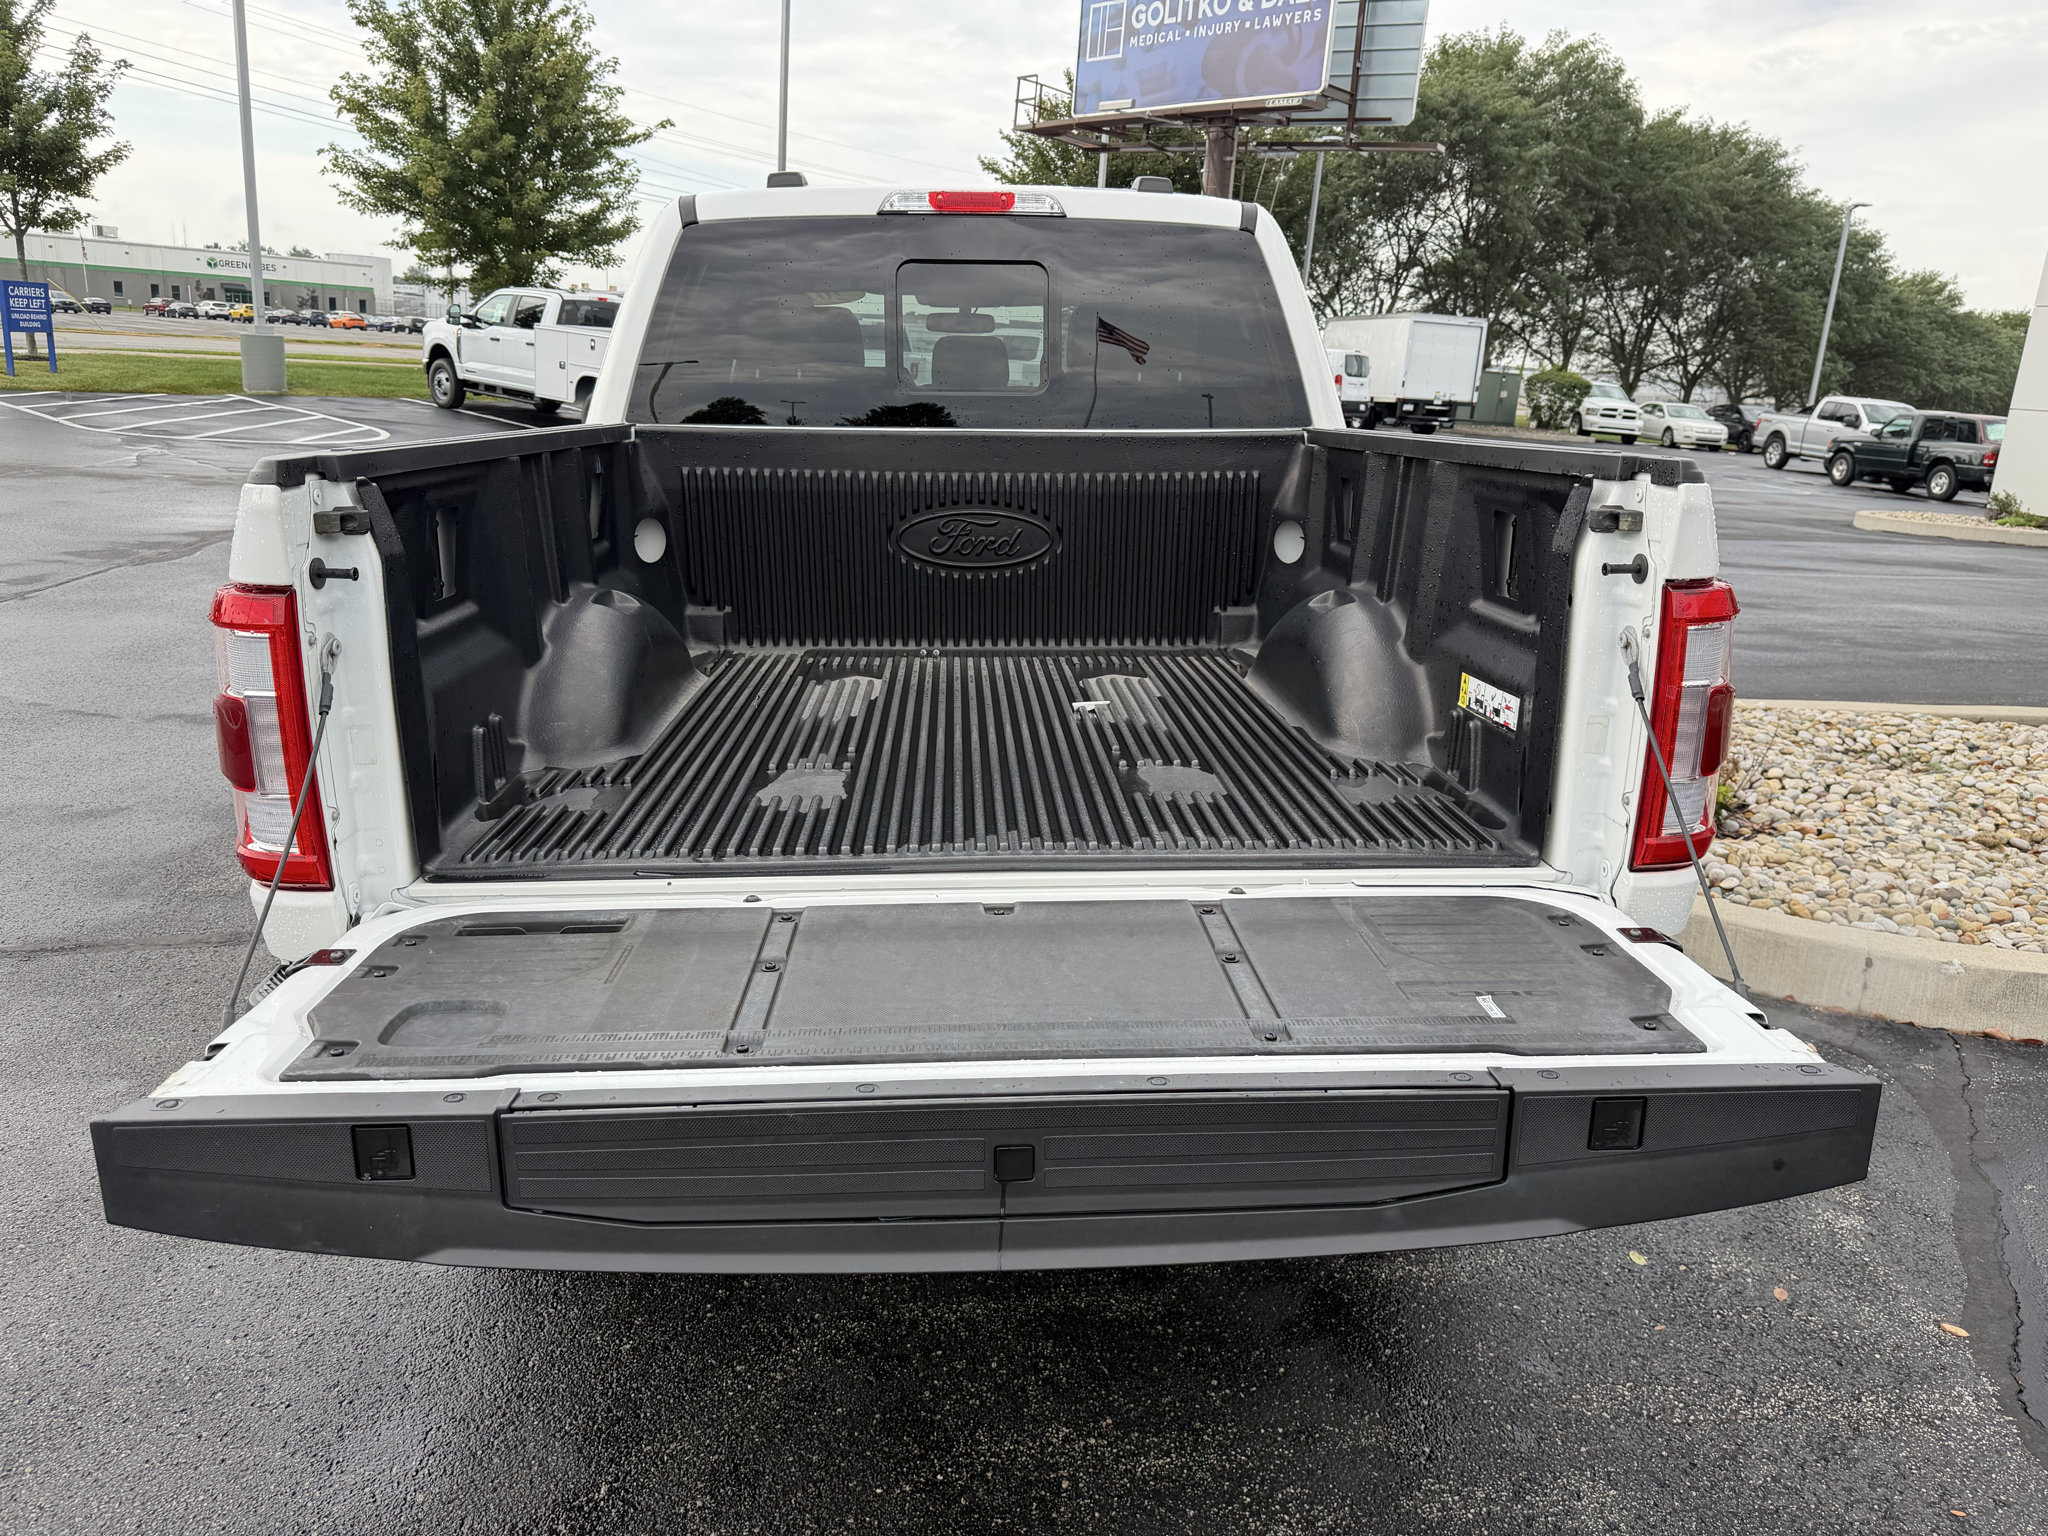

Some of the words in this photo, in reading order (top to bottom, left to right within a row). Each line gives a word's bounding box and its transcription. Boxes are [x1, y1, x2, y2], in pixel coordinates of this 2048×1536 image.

[1132, 0, 1231, 29] GOLITKO
[1129, 29, 1181, 48] MEDICAL
[1193, 20, 1241, 39] INJURY
[1254, 8, 1322, 30] LAWYERS
[219, 260, 248, 269] GREEN
[8, 286, 45, 298] CARRIERS
[10, 298, 28, 308] KEEP
[29, 299, 45, 308] LEFT
[929, 518, 1023, 556] Ford
